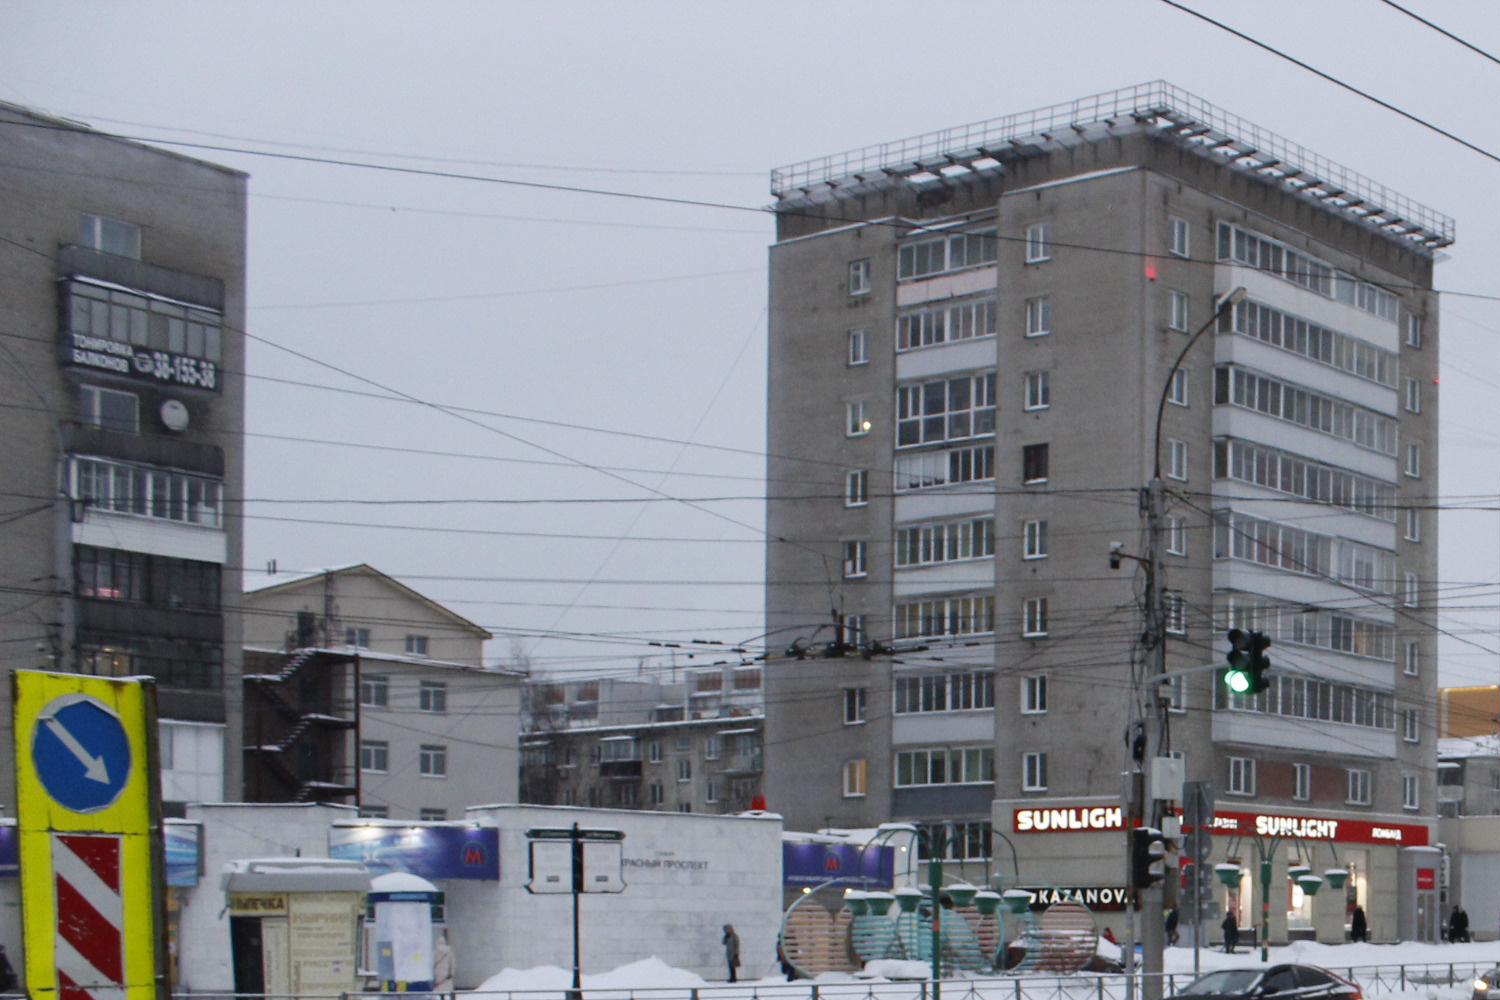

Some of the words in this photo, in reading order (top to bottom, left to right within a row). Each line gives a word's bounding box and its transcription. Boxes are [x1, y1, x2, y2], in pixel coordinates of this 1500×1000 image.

[1017, 807, 1122, 831] SUNLIGH
[1256, 815, 1338, 839] SUNLIGHT
[663, 860, 709, 870] ПРОСПЕКТ
